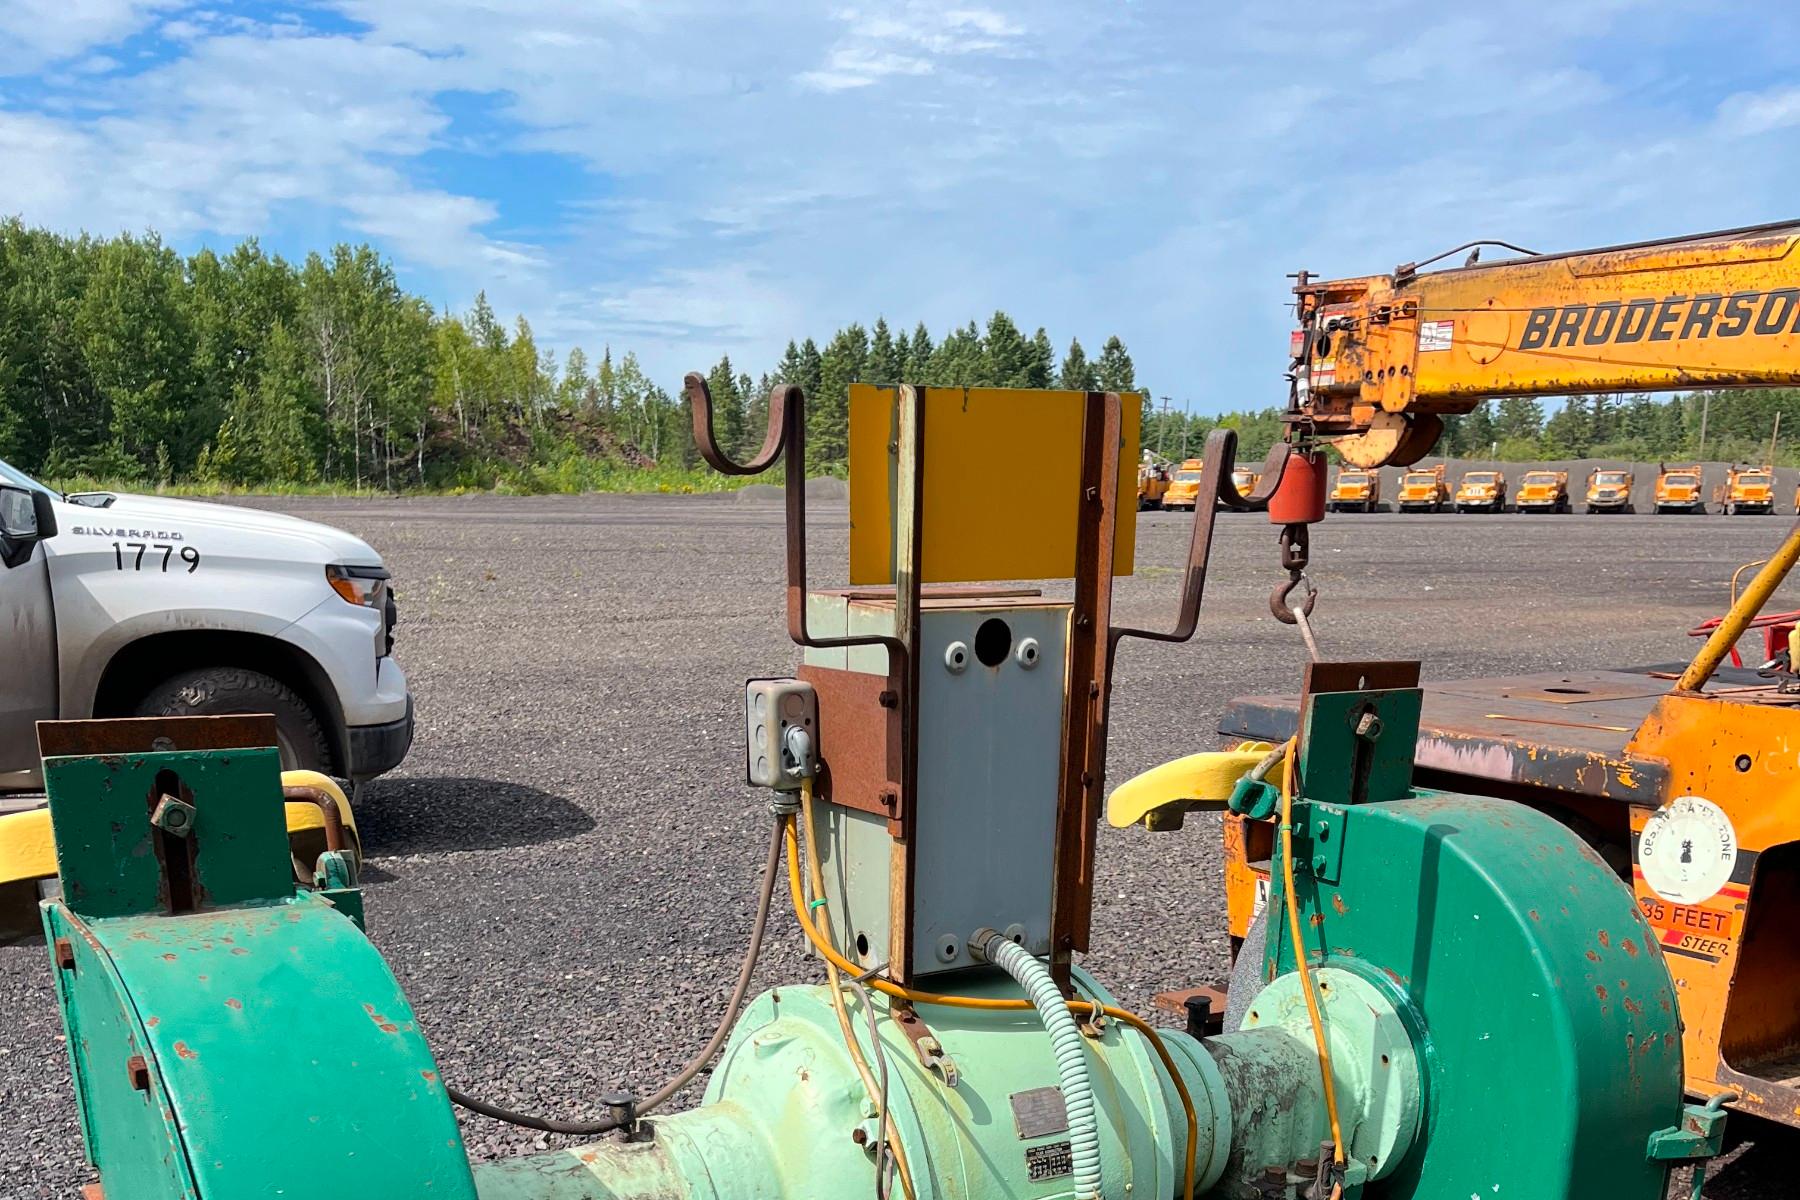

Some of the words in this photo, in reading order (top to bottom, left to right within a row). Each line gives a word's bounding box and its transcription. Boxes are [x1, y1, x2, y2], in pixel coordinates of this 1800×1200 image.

[1519, 286, 1800, 350] BRODERSO
[72, 526, 184, 541] SILVERADO
[112, 541, 200, 574] 1779
[1671, 906, 1727, 931] FEET
